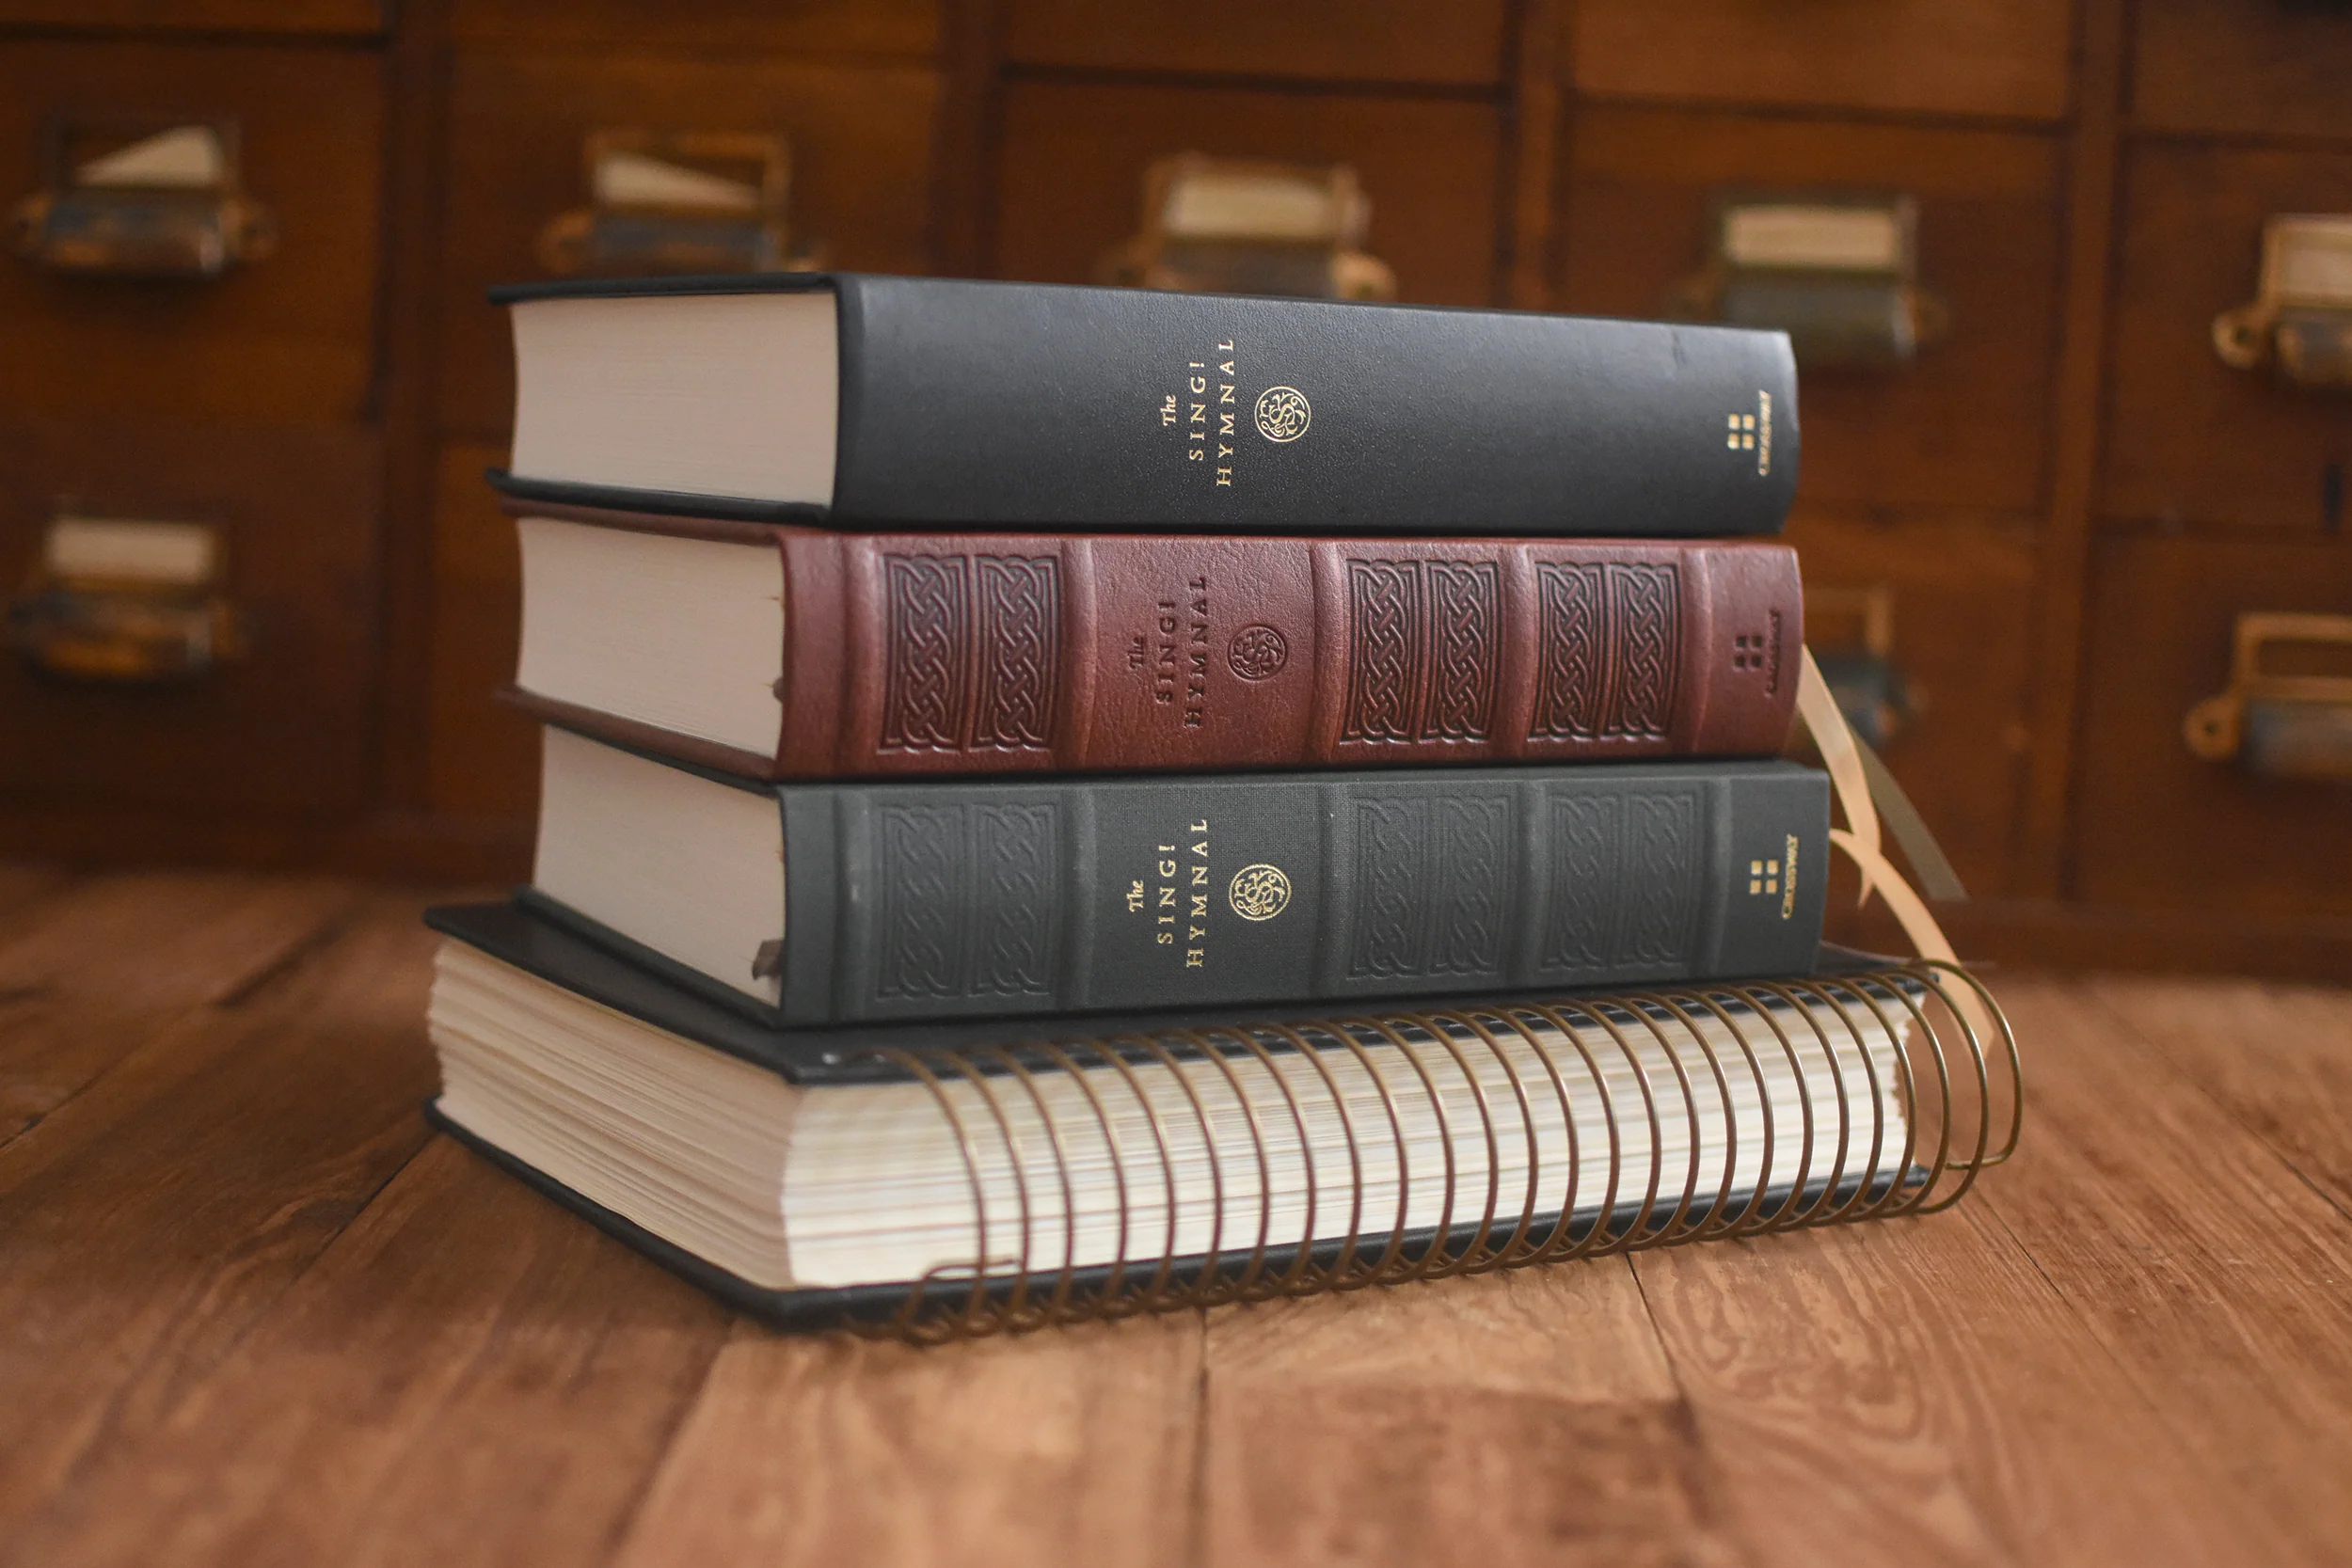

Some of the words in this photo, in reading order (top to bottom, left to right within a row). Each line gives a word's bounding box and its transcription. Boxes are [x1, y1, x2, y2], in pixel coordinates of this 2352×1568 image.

[1161, 395, 1176, 426] The
[1189, 362, 1206, 460] SING!
[1216, 340, 1235, 486] HYMNAL
[1128, 637, 1146, 670] The
[1156, 602, 1175, 704] SING!
[1184, 576, 1208, 727] HYMNAL
[1126, 879, 1144, 912] The
[1157, 845, 1176, 944] SING!
[1186, 819, 1209, 967] HYMNAL
